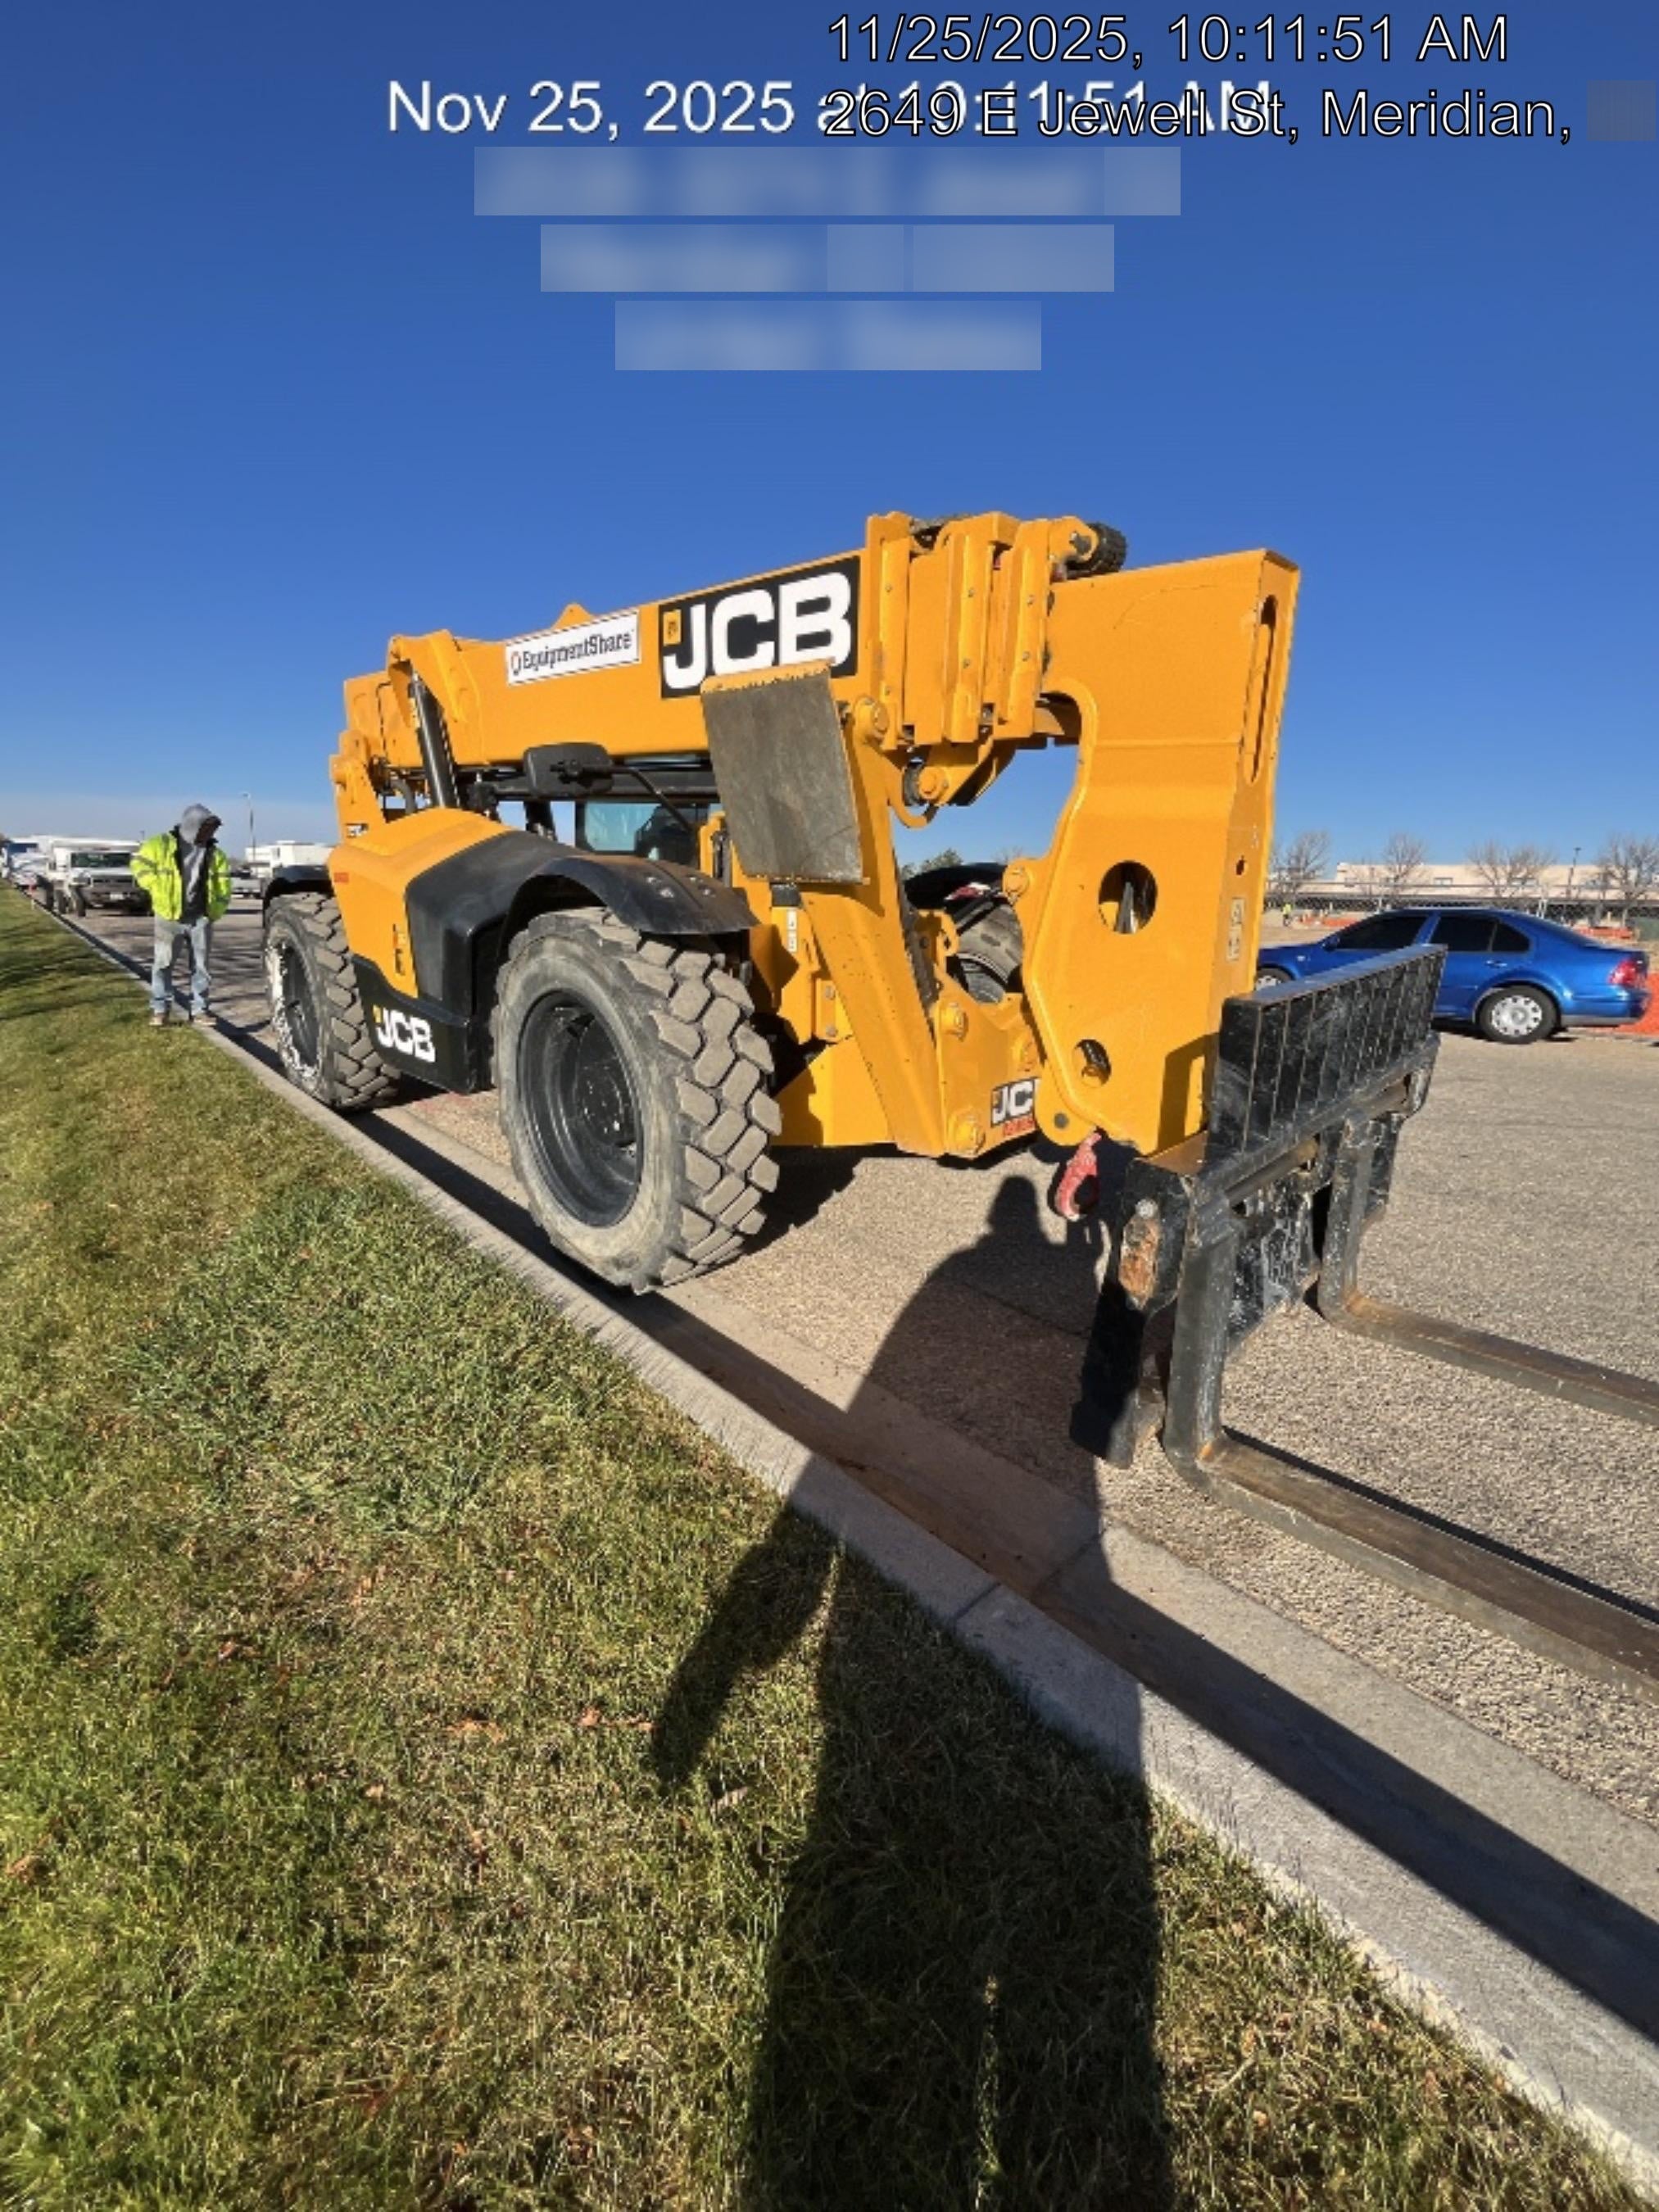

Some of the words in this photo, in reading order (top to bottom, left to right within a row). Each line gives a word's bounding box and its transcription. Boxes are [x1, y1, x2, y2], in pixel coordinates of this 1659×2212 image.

[522, 632, 632, 672] EquipmentShare
[663, 571, 852, 690] JCB
[376, 1006, 436, 1063] JCB
[992, 1078, 1041, 1125] JC
